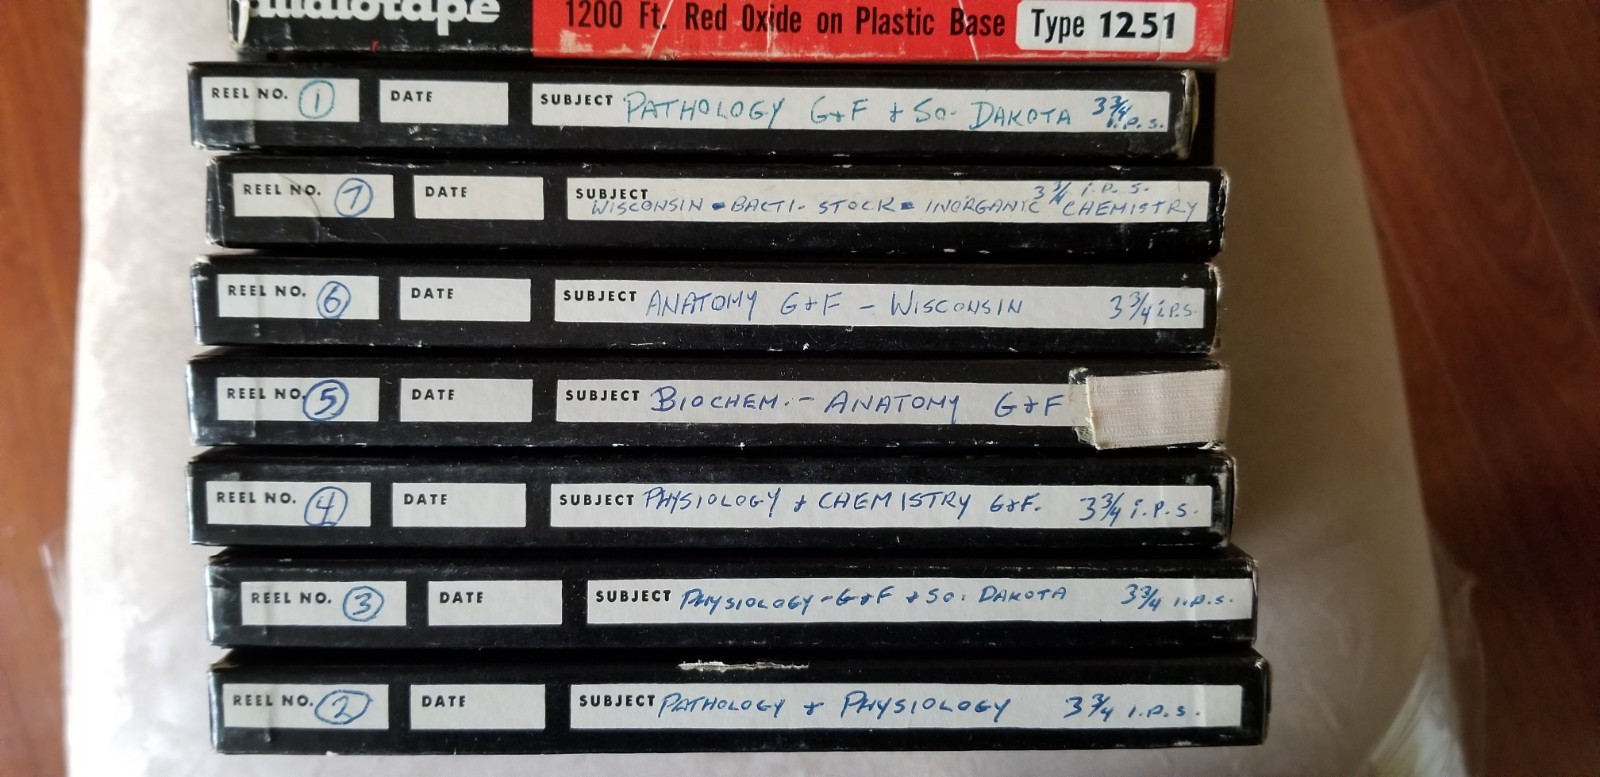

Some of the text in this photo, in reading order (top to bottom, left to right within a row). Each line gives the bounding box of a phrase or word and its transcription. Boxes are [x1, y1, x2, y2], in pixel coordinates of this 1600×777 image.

[565, 0, 1005, 36] 1200 Ft. Red Oxide on Plastic Base
[1031, 9, 1176, 43] Type 1251
[211, 87, 288, 100] REEL NO.
[391, 90, 433, 102] DATE
[540, 94, 613, 107] SUBJECT
[623, 91, 785, 129] PATHOLOGY
[969, 101, 1071, 130] DAKOTA
[243, 184, 321, 196] REEL NO.
[425, 186, 468, 198] DATE
[576, 188, 649, 200] SUBJECT
[591, 198, 705, 215] WISCONSIN
[819, 198, 895, 214] STOCK
[925, 197, 1040, 214] INORGANIC
[1062, 200, 1198, 222] CHEMISTRY
[228, 285, 306, 297] REEL NO.
[411, 287, 454, 299] DATE
[563, 290, 638, 302] SUBJECT
[645, 289, 758, 321] ANATOMY
[890, 289, 1023, 316] WISCONSIN
[227, 388, 306, 400] REEL NO.
[412, 388, 455, 400] DATE
[566, 390, 640, 402] SUBJECT
[824, 390, 960, 425] ANATOMY
[217, 491, 296, 504] REEL NO.
[403, 493, 447, 505] DATE
[560, 494, 635, 506] SUBJECT
[642, 486, 781, 518] PHYSIOLOGY
[818, 491, 971, 520] CHEMISTRY
[251, 591, 331, 604] REEL NO.
[439, 591, 484, 604] DATE
[596, 589, 672, 602] SUBJECT
[978, 585, 1068, 603] DAKOTA
[233, 695, 313, 707] REEL NO.
[422, 695, 466, 707] DATE
[579, 694, 655, 707] SUBJECT
[657, 691, 786, 719] PATHOLOGY
[840, 690, 1011, 723] PHYSIOLOGY
